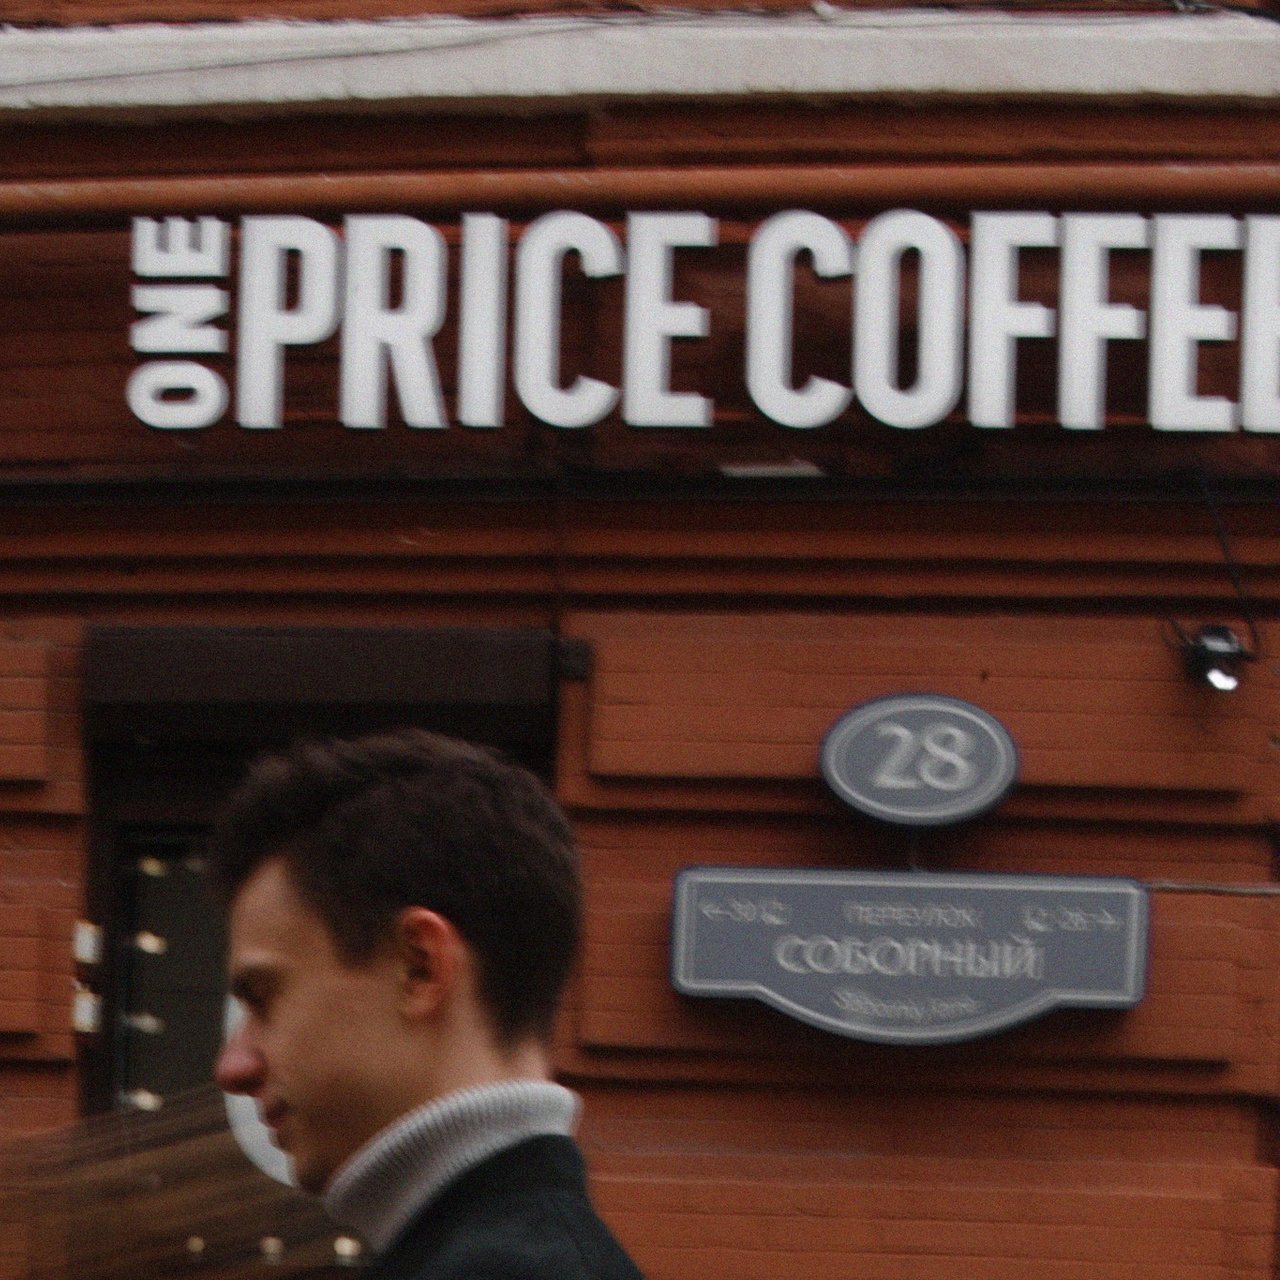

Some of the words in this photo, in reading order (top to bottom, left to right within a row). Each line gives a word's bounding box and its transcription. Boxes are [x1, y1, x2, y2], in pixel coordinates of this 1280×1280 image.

[127, 215, 231, 429] ONE
[237, 210, 717, 430] PRICE
[871, 721, 980, 793] 28
[773, 931, 1046, 980] СОБОРНЫЙ
